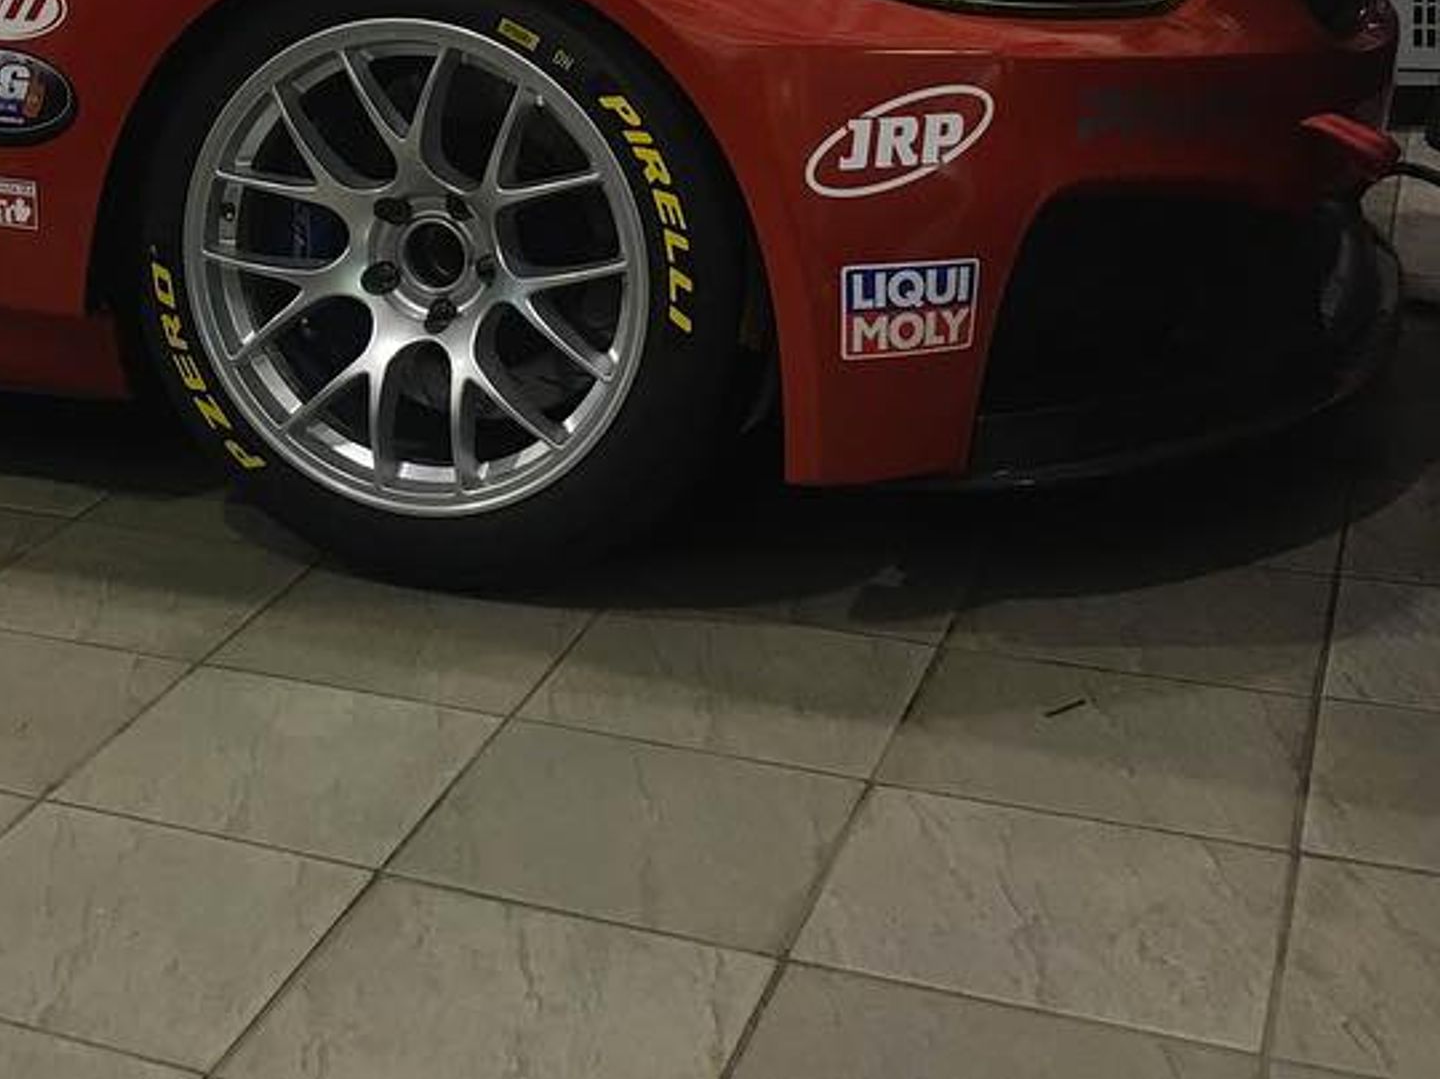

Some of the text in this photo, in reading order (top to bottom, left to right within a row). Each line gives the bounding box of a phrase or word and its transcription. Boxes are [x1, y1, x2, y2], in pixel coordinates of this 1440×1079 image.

[838, 111, 964, 171] JRP
[598, 94, 693, 335] PIRELLI
[851, 265, 971, 311] LIQUI
[851, 309, 970, 353] MOLY
